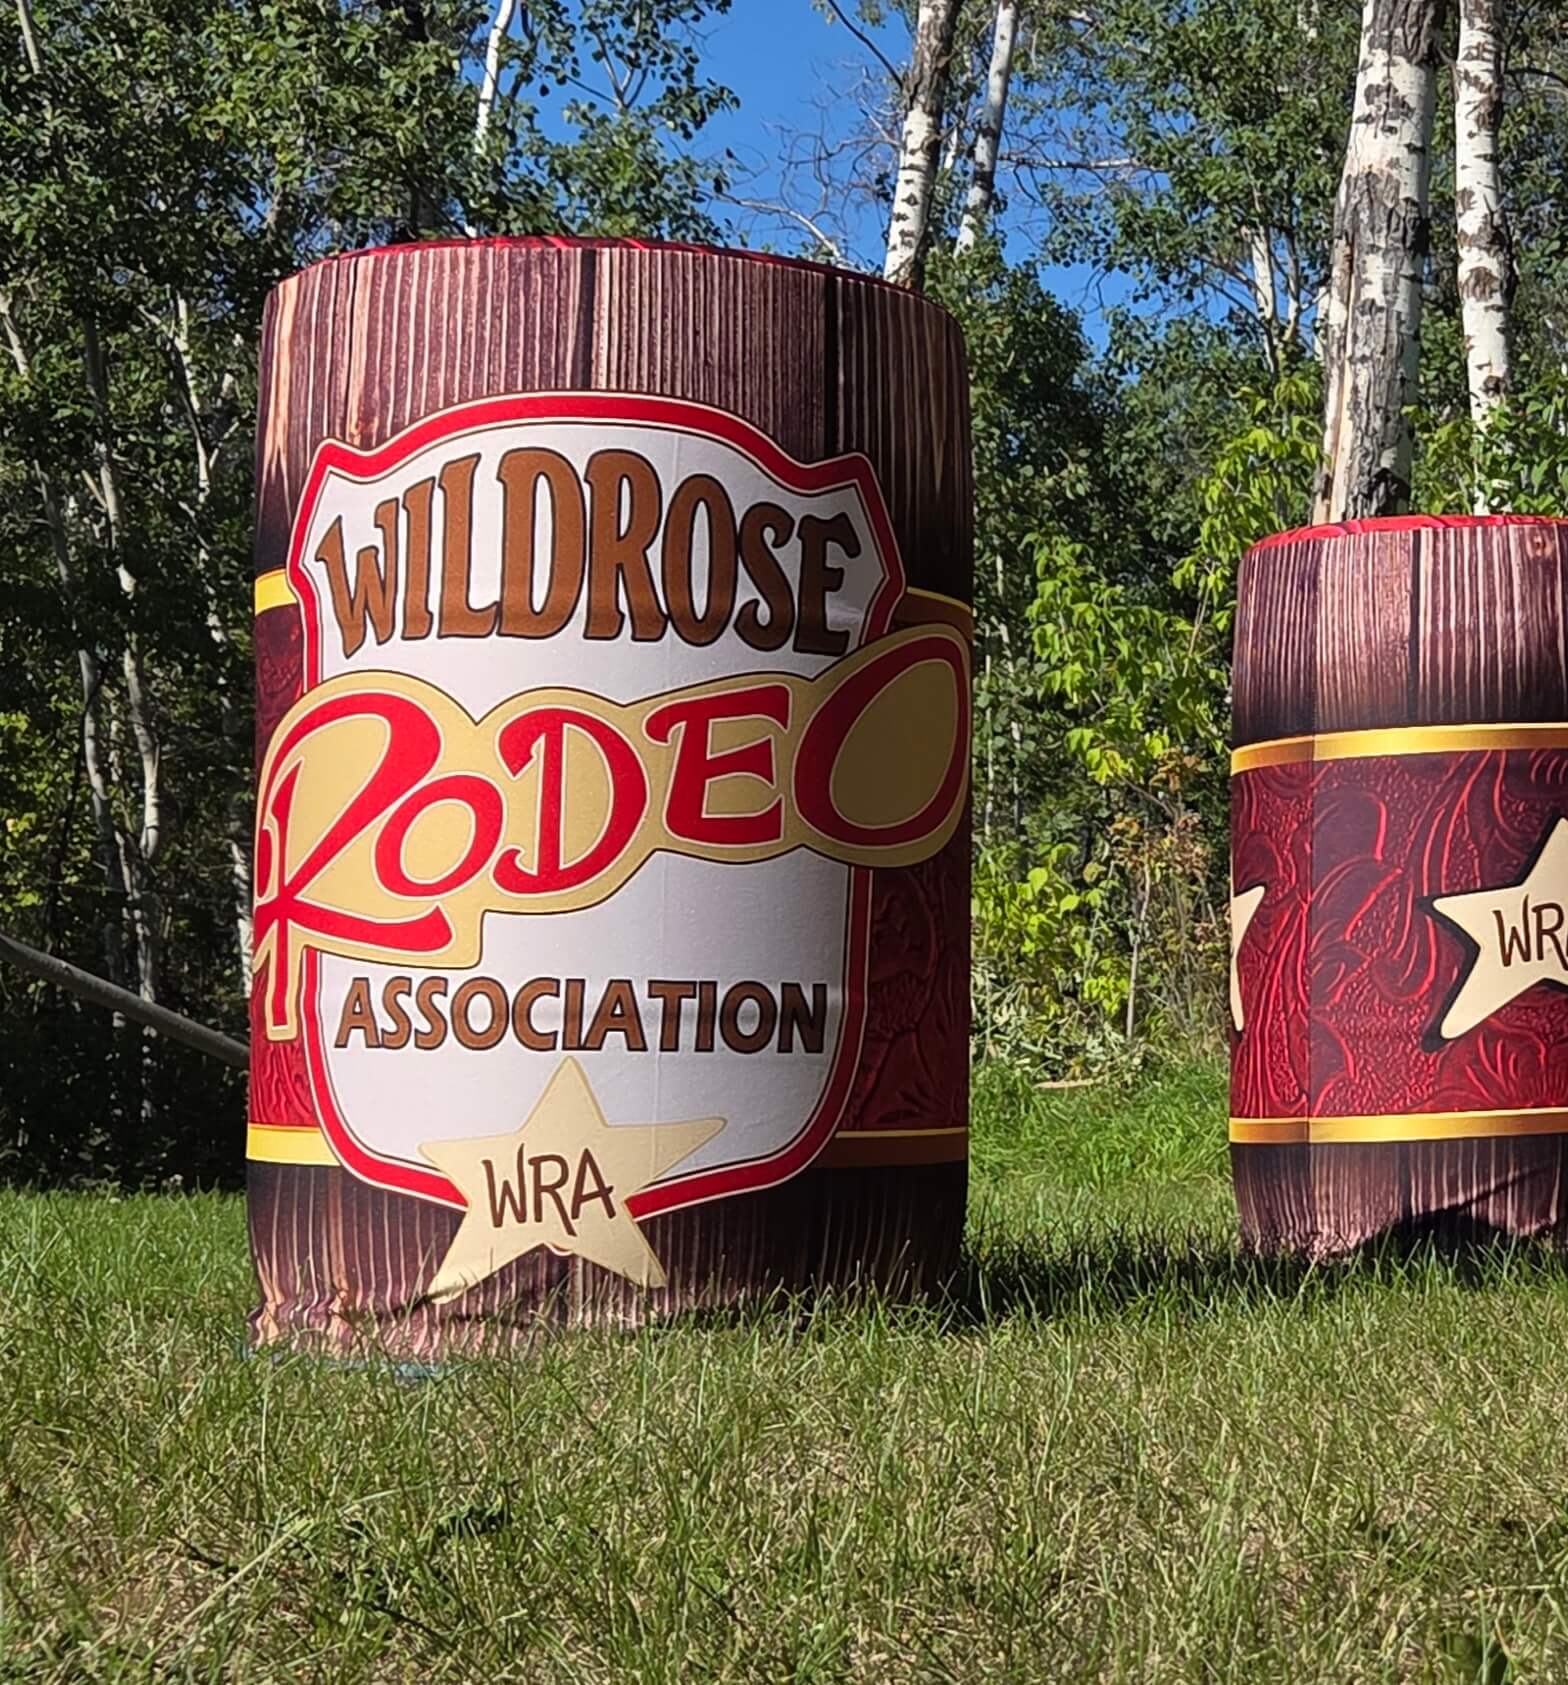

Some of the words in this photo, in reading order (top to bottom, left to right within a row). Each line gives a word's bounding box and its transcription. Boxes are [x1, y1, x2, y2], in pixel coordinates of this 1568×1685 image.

[315, 446, 861, 659] WILDROSE
[334, 976, 827, 1054] ASSOCIATION
[483, 1143, 616, 1236] WRA
